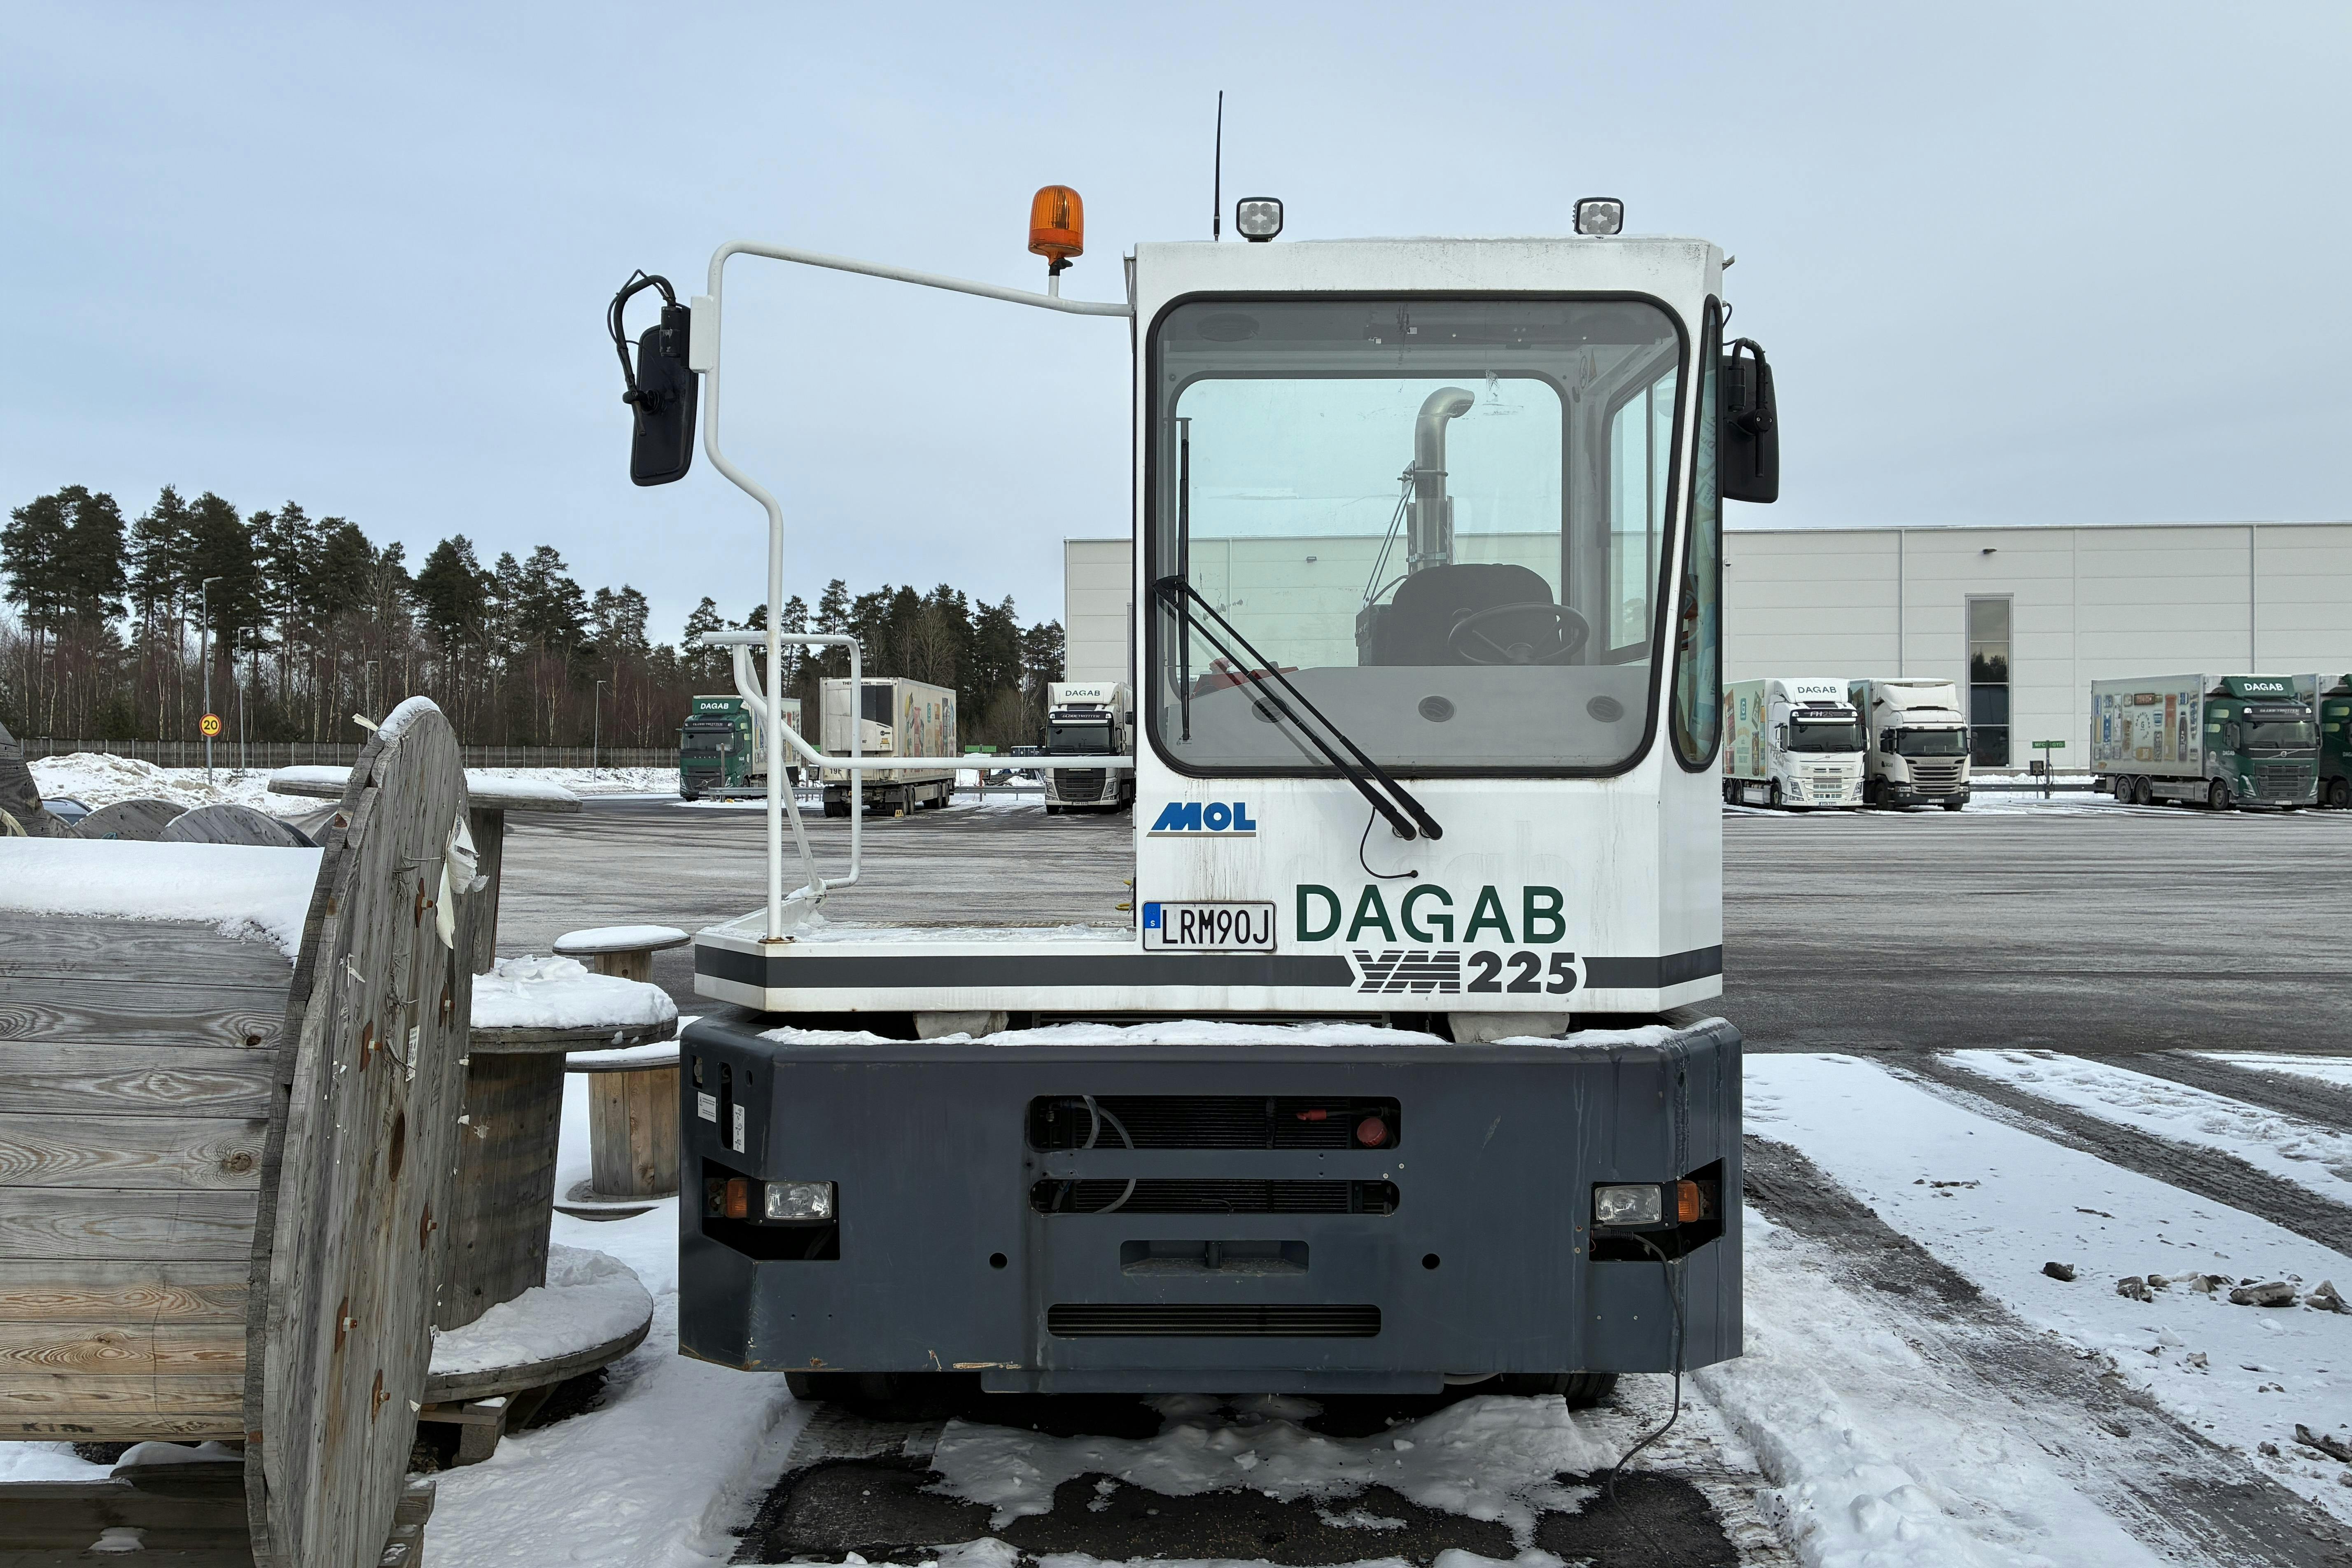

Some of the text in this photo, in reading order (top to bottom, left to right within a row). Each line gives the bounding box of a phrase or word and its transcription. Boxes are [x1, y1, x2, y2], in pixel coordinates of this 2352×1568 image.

[2244, 683, 2284, 691] DAGAB
[203, 720, 218, 730] 20
[1150, 802, 1256, 831] MOL
[1162, 910, 1269, 944] LRM90J
[1296, 884, 1566, 944] DAGAB
[1352, 950, 1577, 994] YM 225
